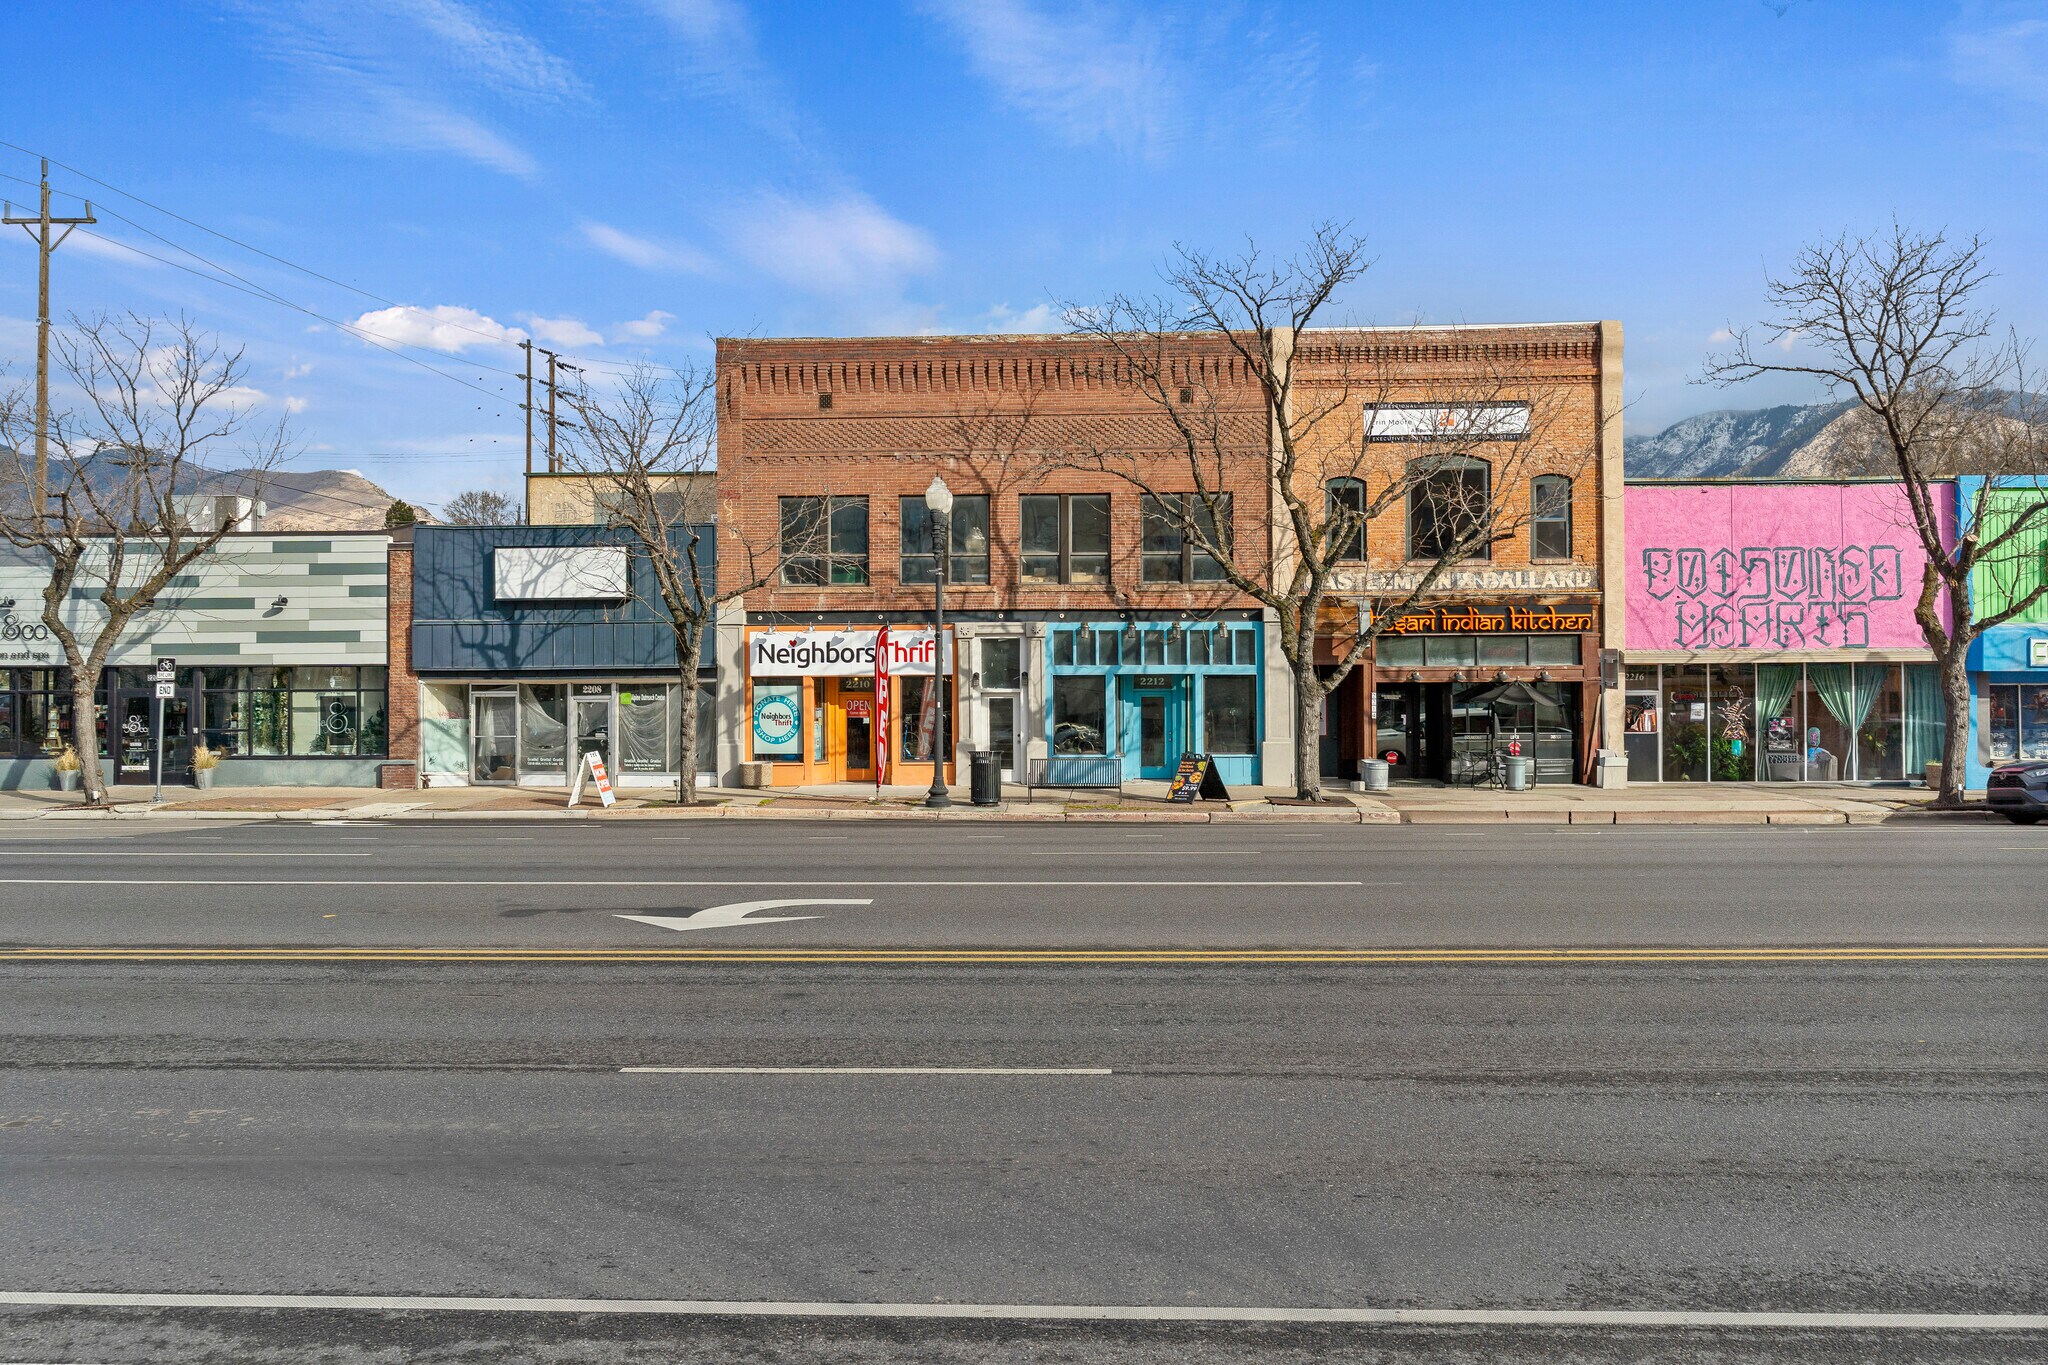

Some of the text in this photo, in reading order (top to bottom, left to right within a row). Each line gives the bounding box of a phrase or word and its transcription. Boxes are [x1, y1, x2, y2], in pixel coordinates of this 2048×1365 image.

[1482, 571, 1592, 588] BALLARD
[1441, 606, 1505, 631] indian
[1509, 605, 1592, 631] kitchen
[10, 650, 30, 660] and
[32, 651, 49, 662] spa
[758, 640, 944, 668] Neighbors hrif
[846, 680, 870, 688] 2210
[1140, 677, 1165, 686] 2212
[159, 686, 171, 694] END
[582, 685, 602, 693] 2208
[754, 696, 799, 716] DONATE HERE
[846, 700, 871, 711] OPEN
[761, 712, 792, 721] Neighbors
[756, 728, 797, 742] SHOP HERE
